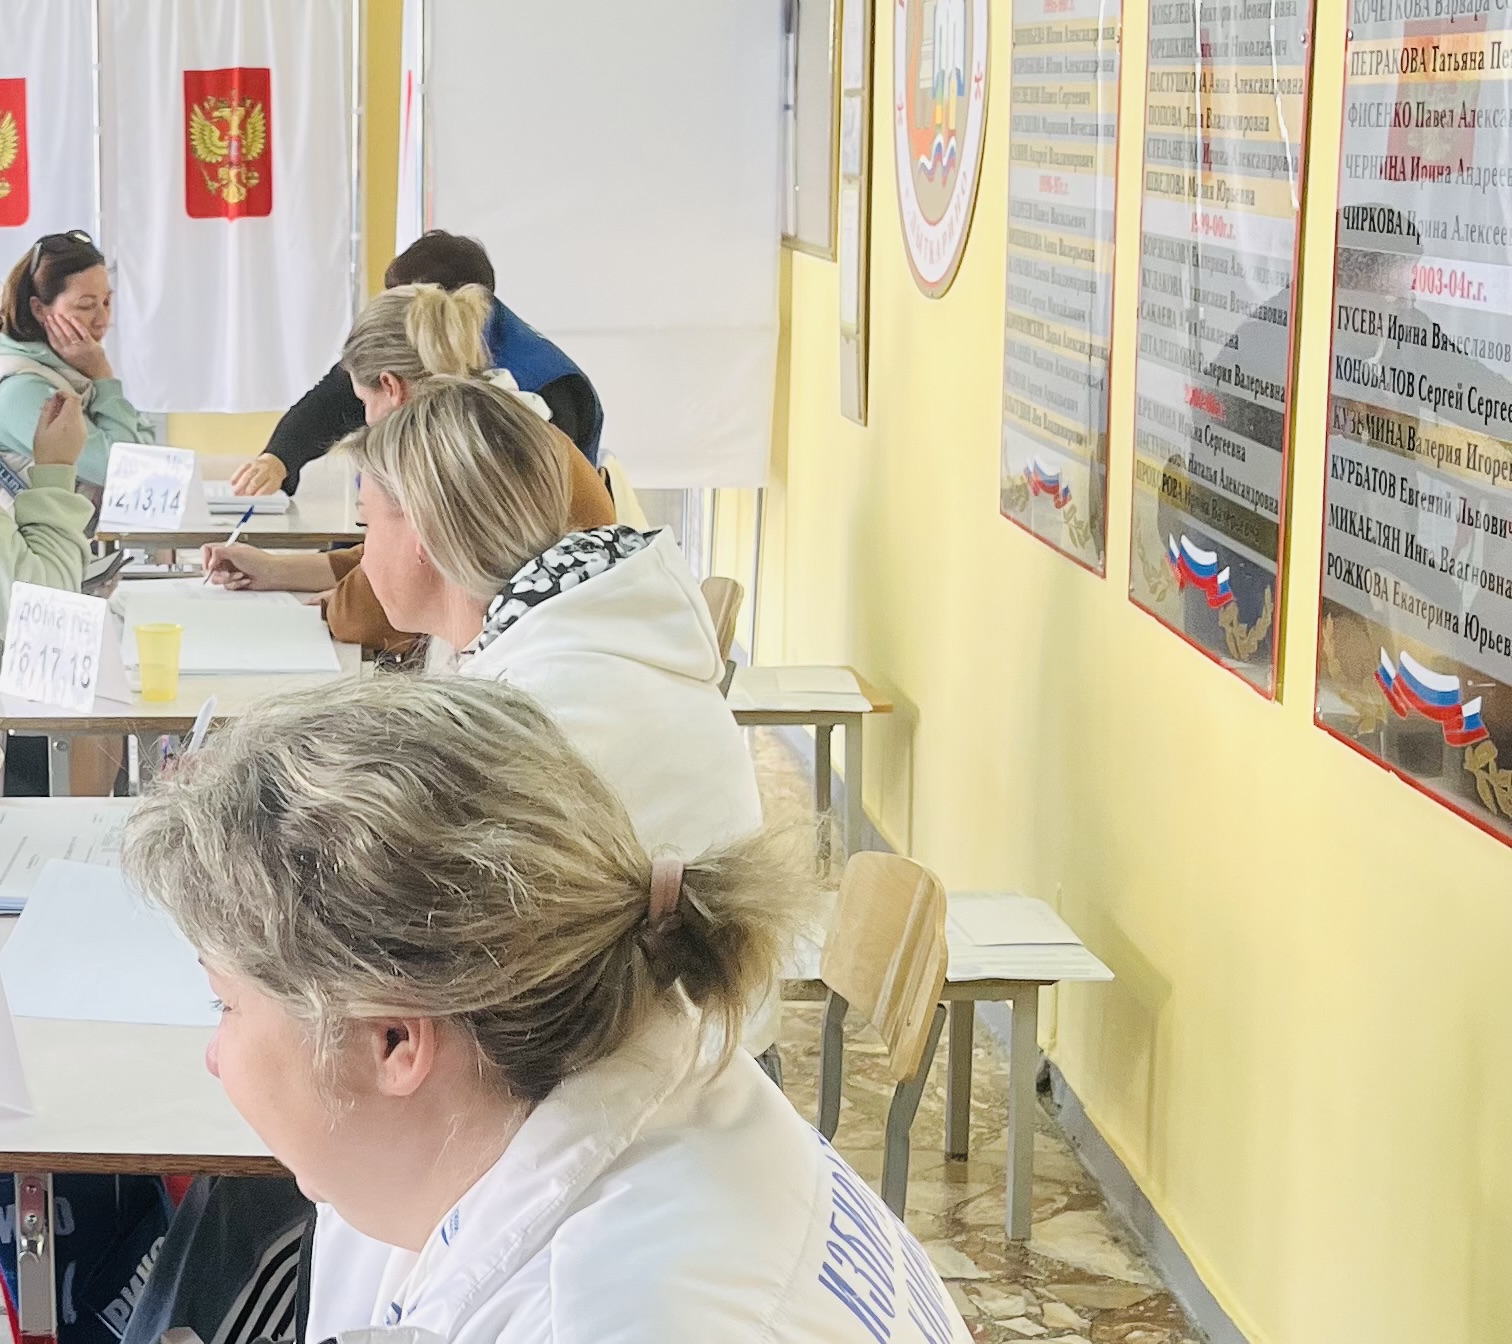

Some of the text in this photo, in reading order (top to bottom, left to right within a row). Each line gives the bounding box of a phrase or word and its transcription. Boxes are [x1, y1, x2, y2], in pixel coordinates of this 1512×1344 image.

[1350, 47, 1427, 76] ПЕТРАКОВА
[1431, 46, 1485, 72] Татьяна
[1348, 101, 1412, 128] ФИСЕНКО
[1415, 101, 1453, 128] Павел
[1410, 156, 1451, 190] Ирина
[1343, 206, 1403, 236] ЧИРКОВА
[1406, 210, 1447, 246] Ирина
[1411, 264, 1488, 303] 2003-04г.г.
[1337, 305, 1384, 338] ГУСЕВА
[1387, 314, 1427, 349] Ирина
[1336, 355, 1415, 398] КОНОВАЛОВ
[1418, 375, 1463, 413] Сергей
[1332, 405, 1404, 451] КУЗЬМИНА
[1407, 426, 1462, 468] Валерия
[1331, 454, 1396, 499] КУРБАТОВ
[1399, 477, 1452, 513] Евгений
[1328, 503, 1401, 554] МИКАЕЛЯН
[1404, 533, 1436, 570] Инга
[1327, 552, 1390, 603] РОЖКОВА
[1393, 581, 1459, 636] Екатерина
